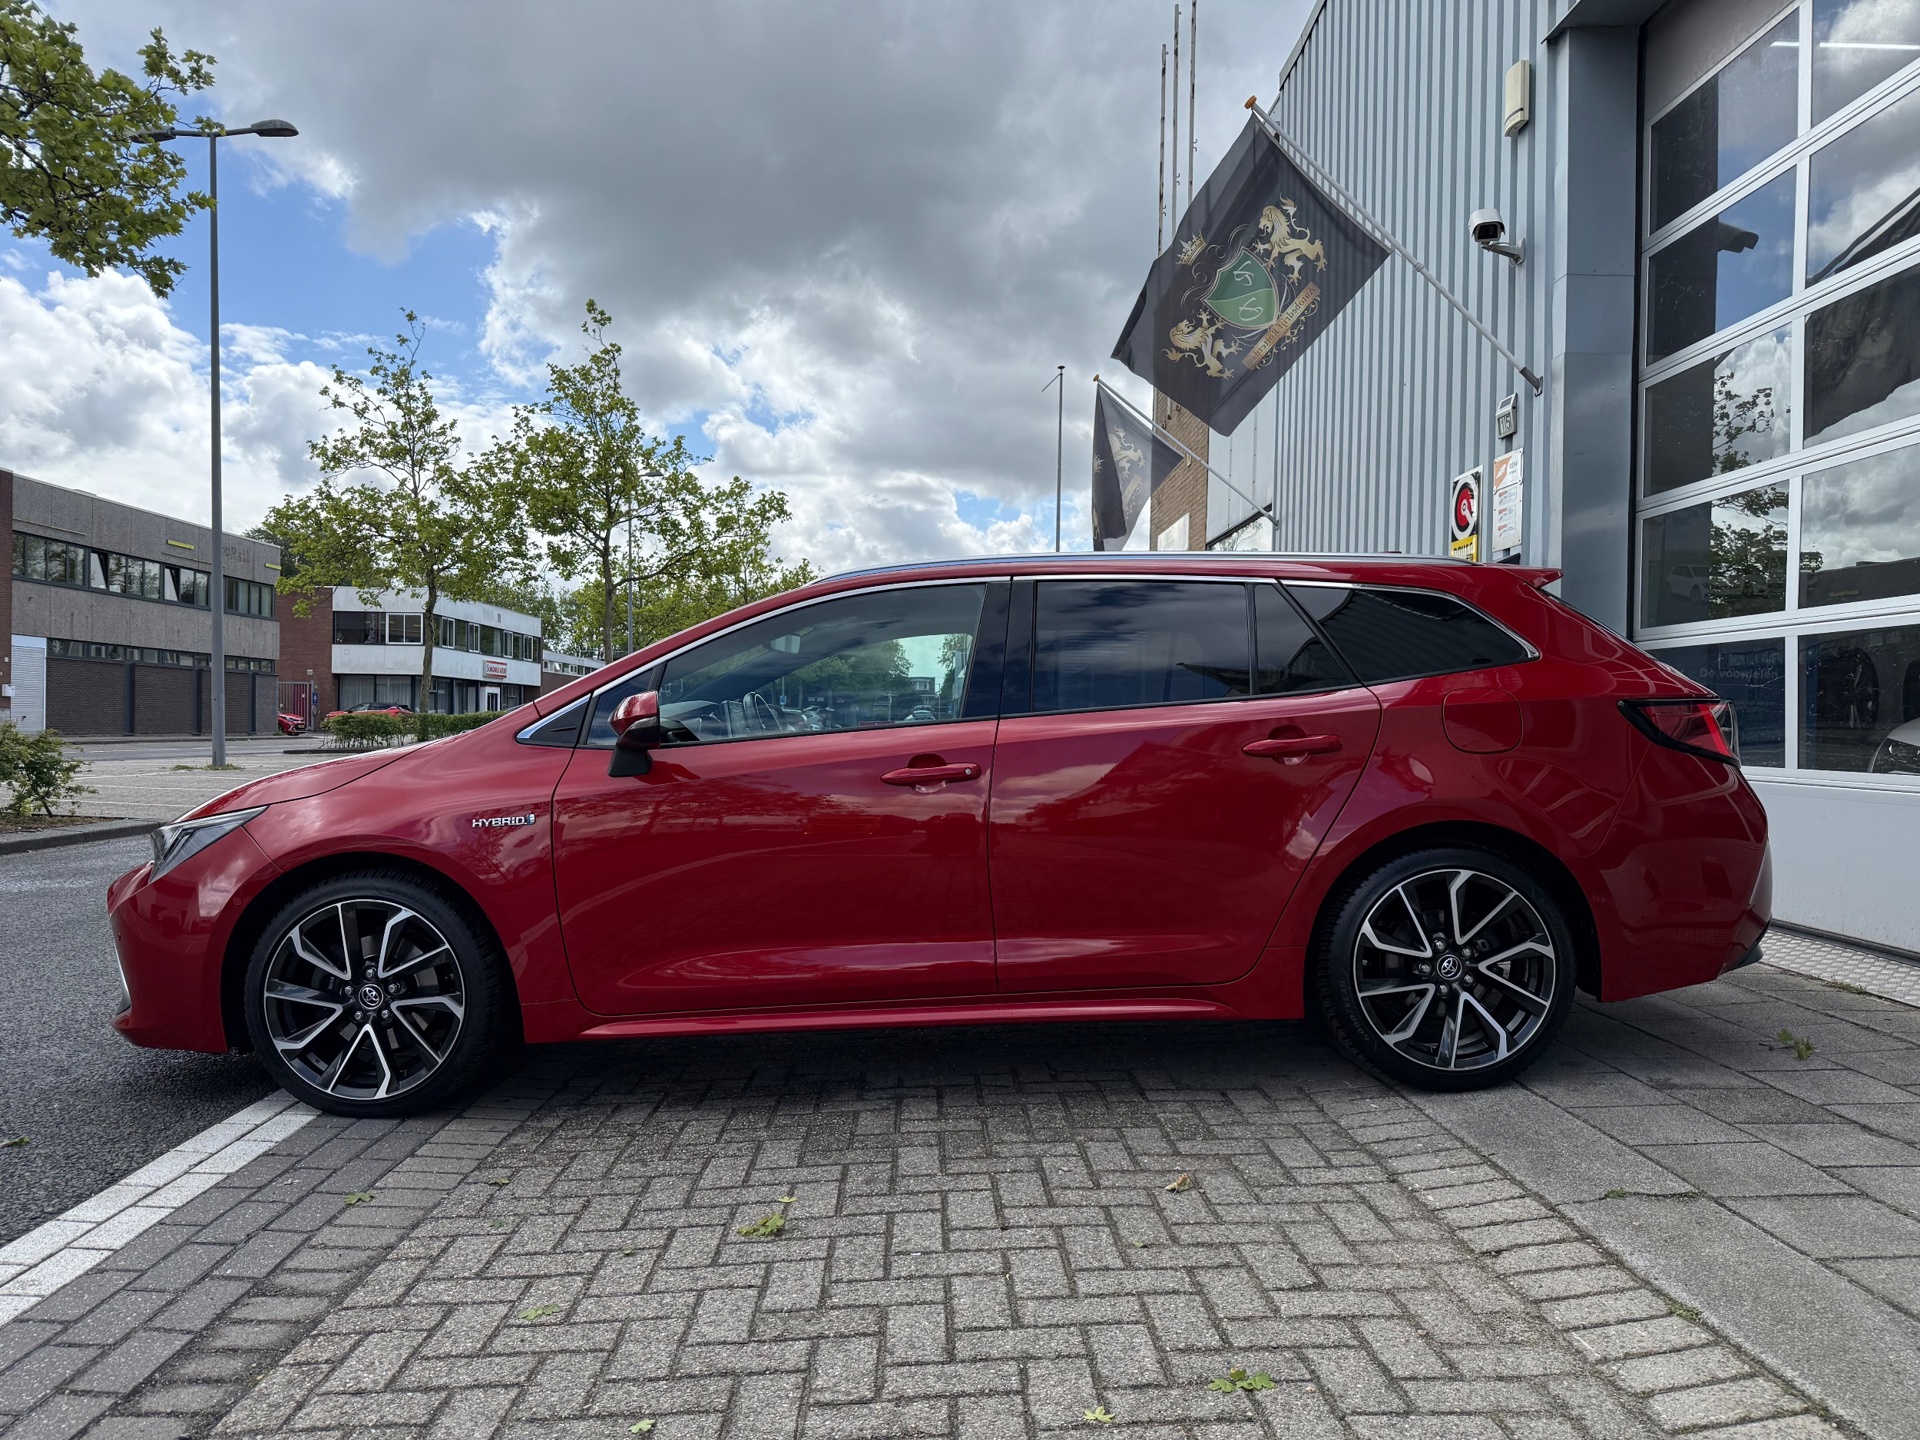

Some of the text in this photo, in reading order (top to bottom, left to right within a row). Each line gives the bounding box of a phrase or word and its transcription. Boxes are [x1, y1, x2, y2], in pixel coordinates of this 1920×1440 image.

[222, 546, 250, 564] oRail
[1699, 668, 1778, 679] De voordelen
[472, 816, 525, 828] HYBRID
